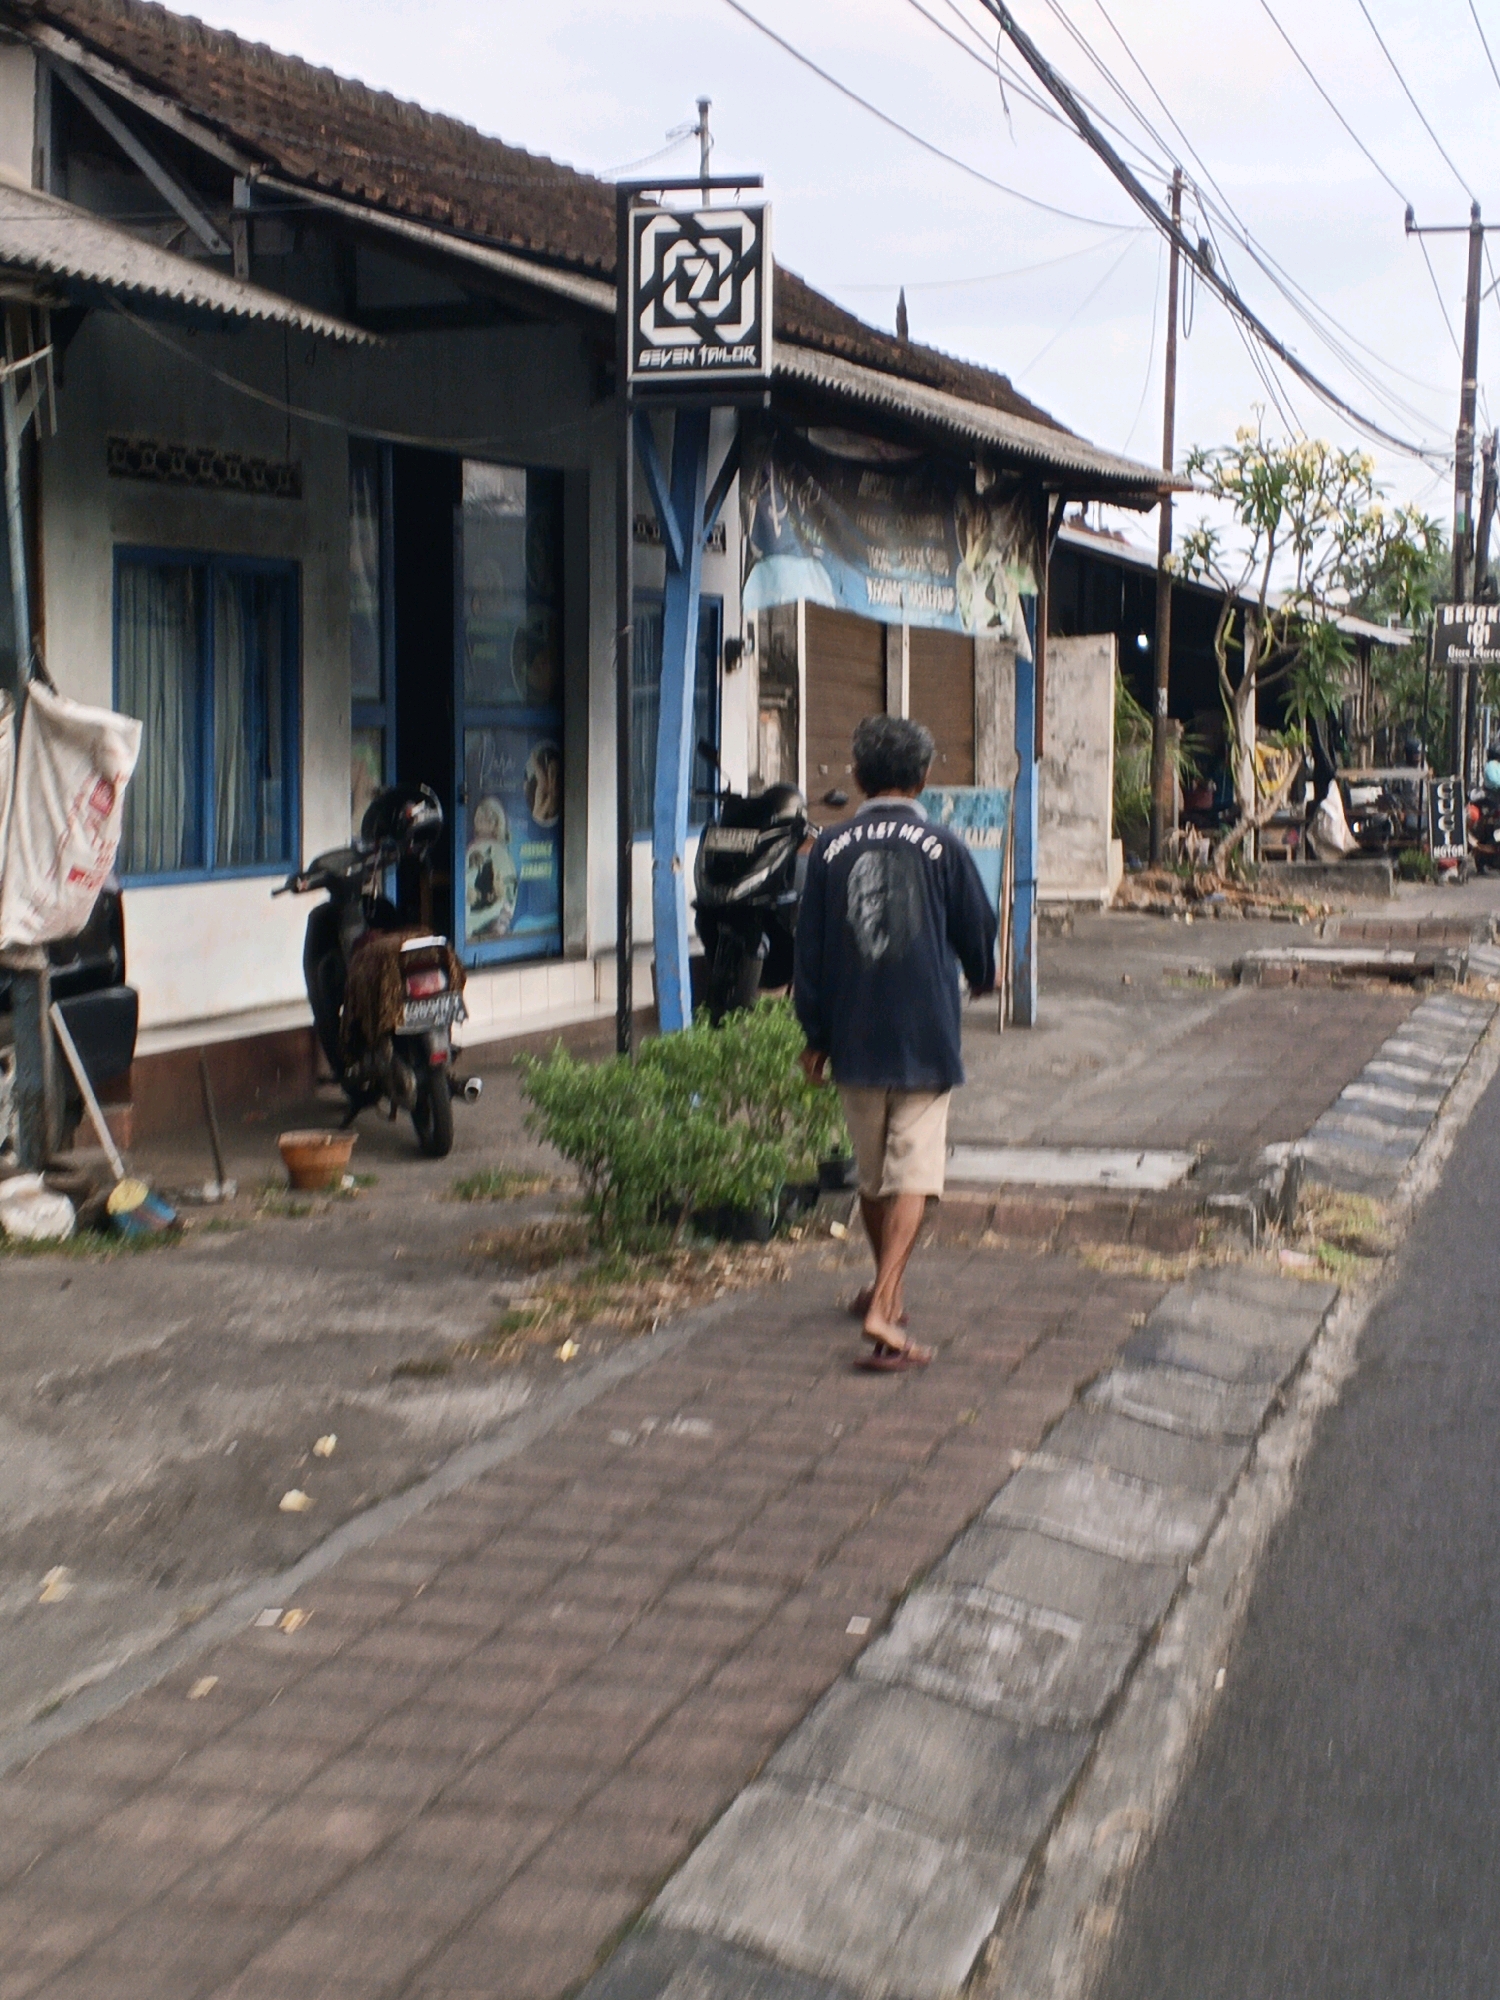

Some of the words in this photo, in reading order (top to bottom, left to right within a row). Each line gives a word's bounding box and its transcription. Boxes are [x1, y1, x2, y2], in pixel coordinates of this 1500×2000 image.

[638, 347, 695, 369] SEVEN
[698, 344, 757, 367] TAILOR
[867, 821, 898, 840] LET
[898, 823, 925, 845] ME
[921, 835, 943, 861] GO
[1433, 845, 1464, 859] MOTOR
